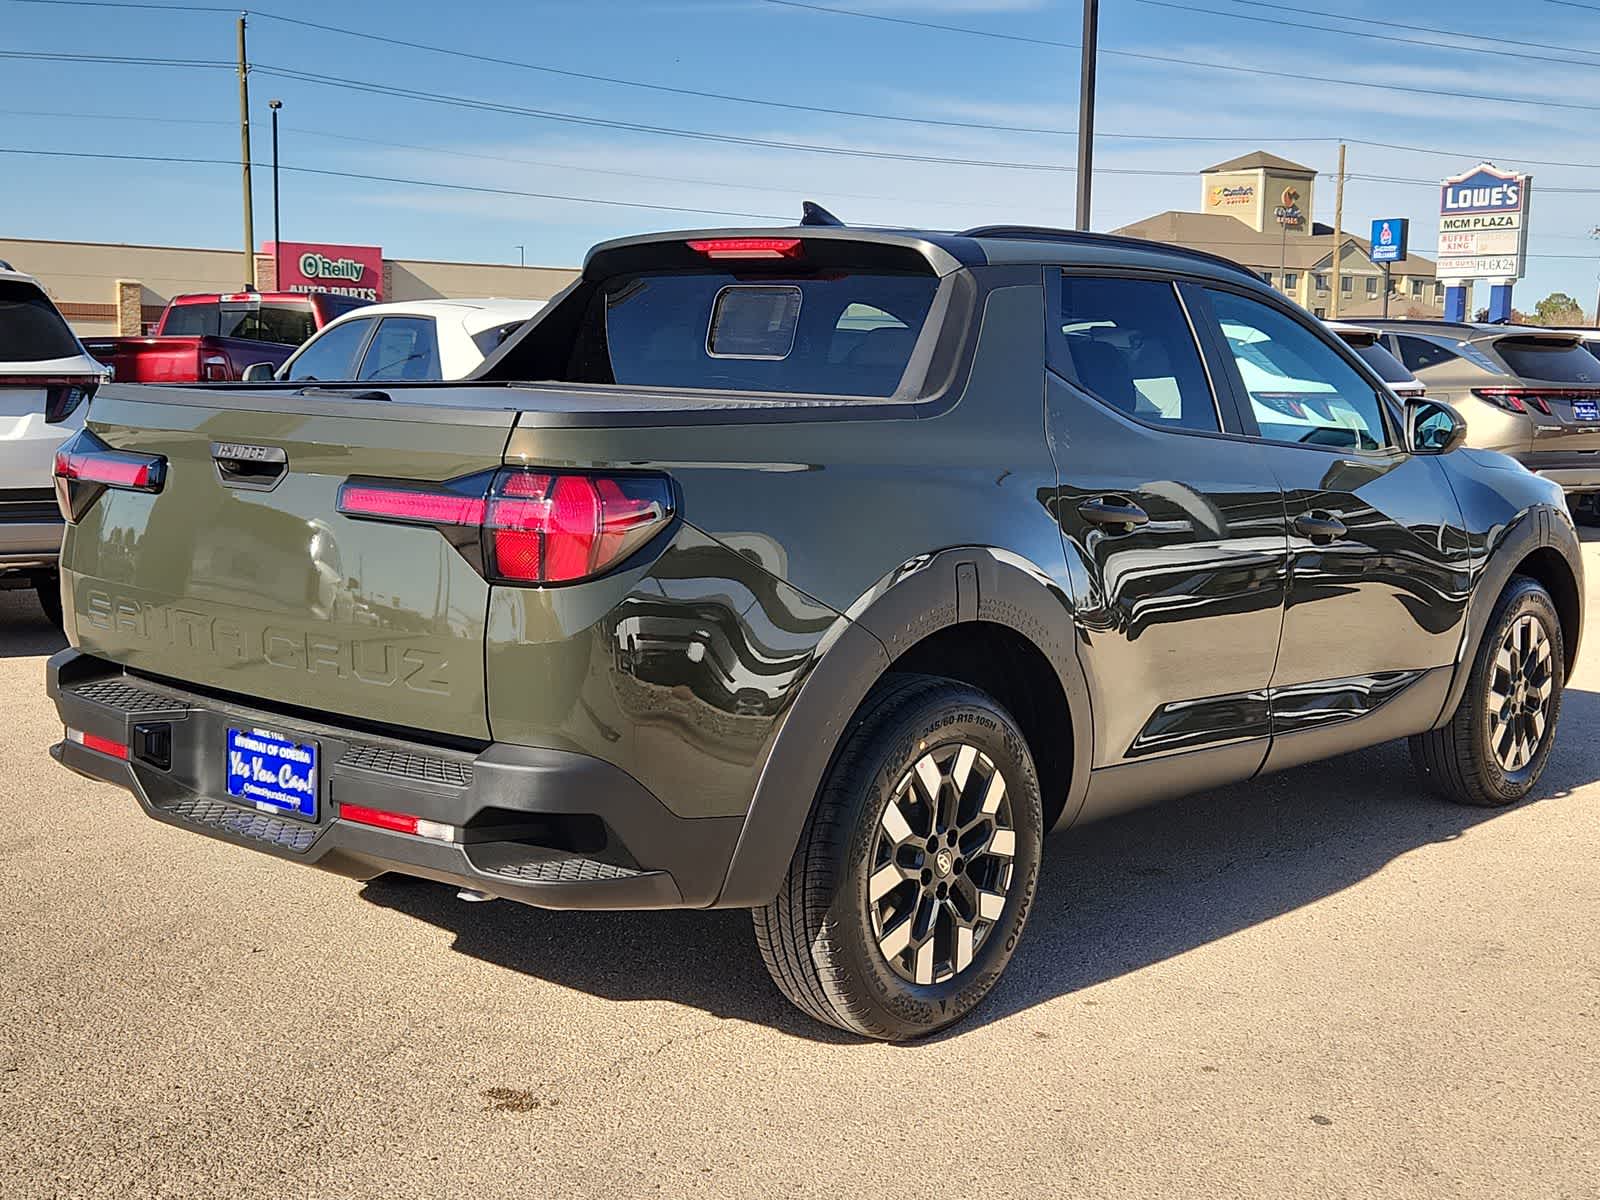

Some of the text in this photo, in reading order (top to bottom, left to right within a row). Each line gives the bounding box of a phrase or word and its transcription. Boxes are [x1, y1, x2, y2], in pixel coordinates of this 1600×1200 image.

[1445, 183, 1518, 209] LOWE'S
[1443, 216, 1514, 230] MCM PLAZA
[1441, 234, 1475, 242] BUFFET
[1447, 242, 1469, 250] KING
[299, 252, 365, 282] O'Reilly
[289, 284, 377, 301] AUTO PARTS
[87, 590, 451, 697] SANTA CRUZ
[267, 744, 279, 756] OF
[230, 750, 315, 795] Yes You Can!
[1005, 862, 1038, 954] KUMHO
